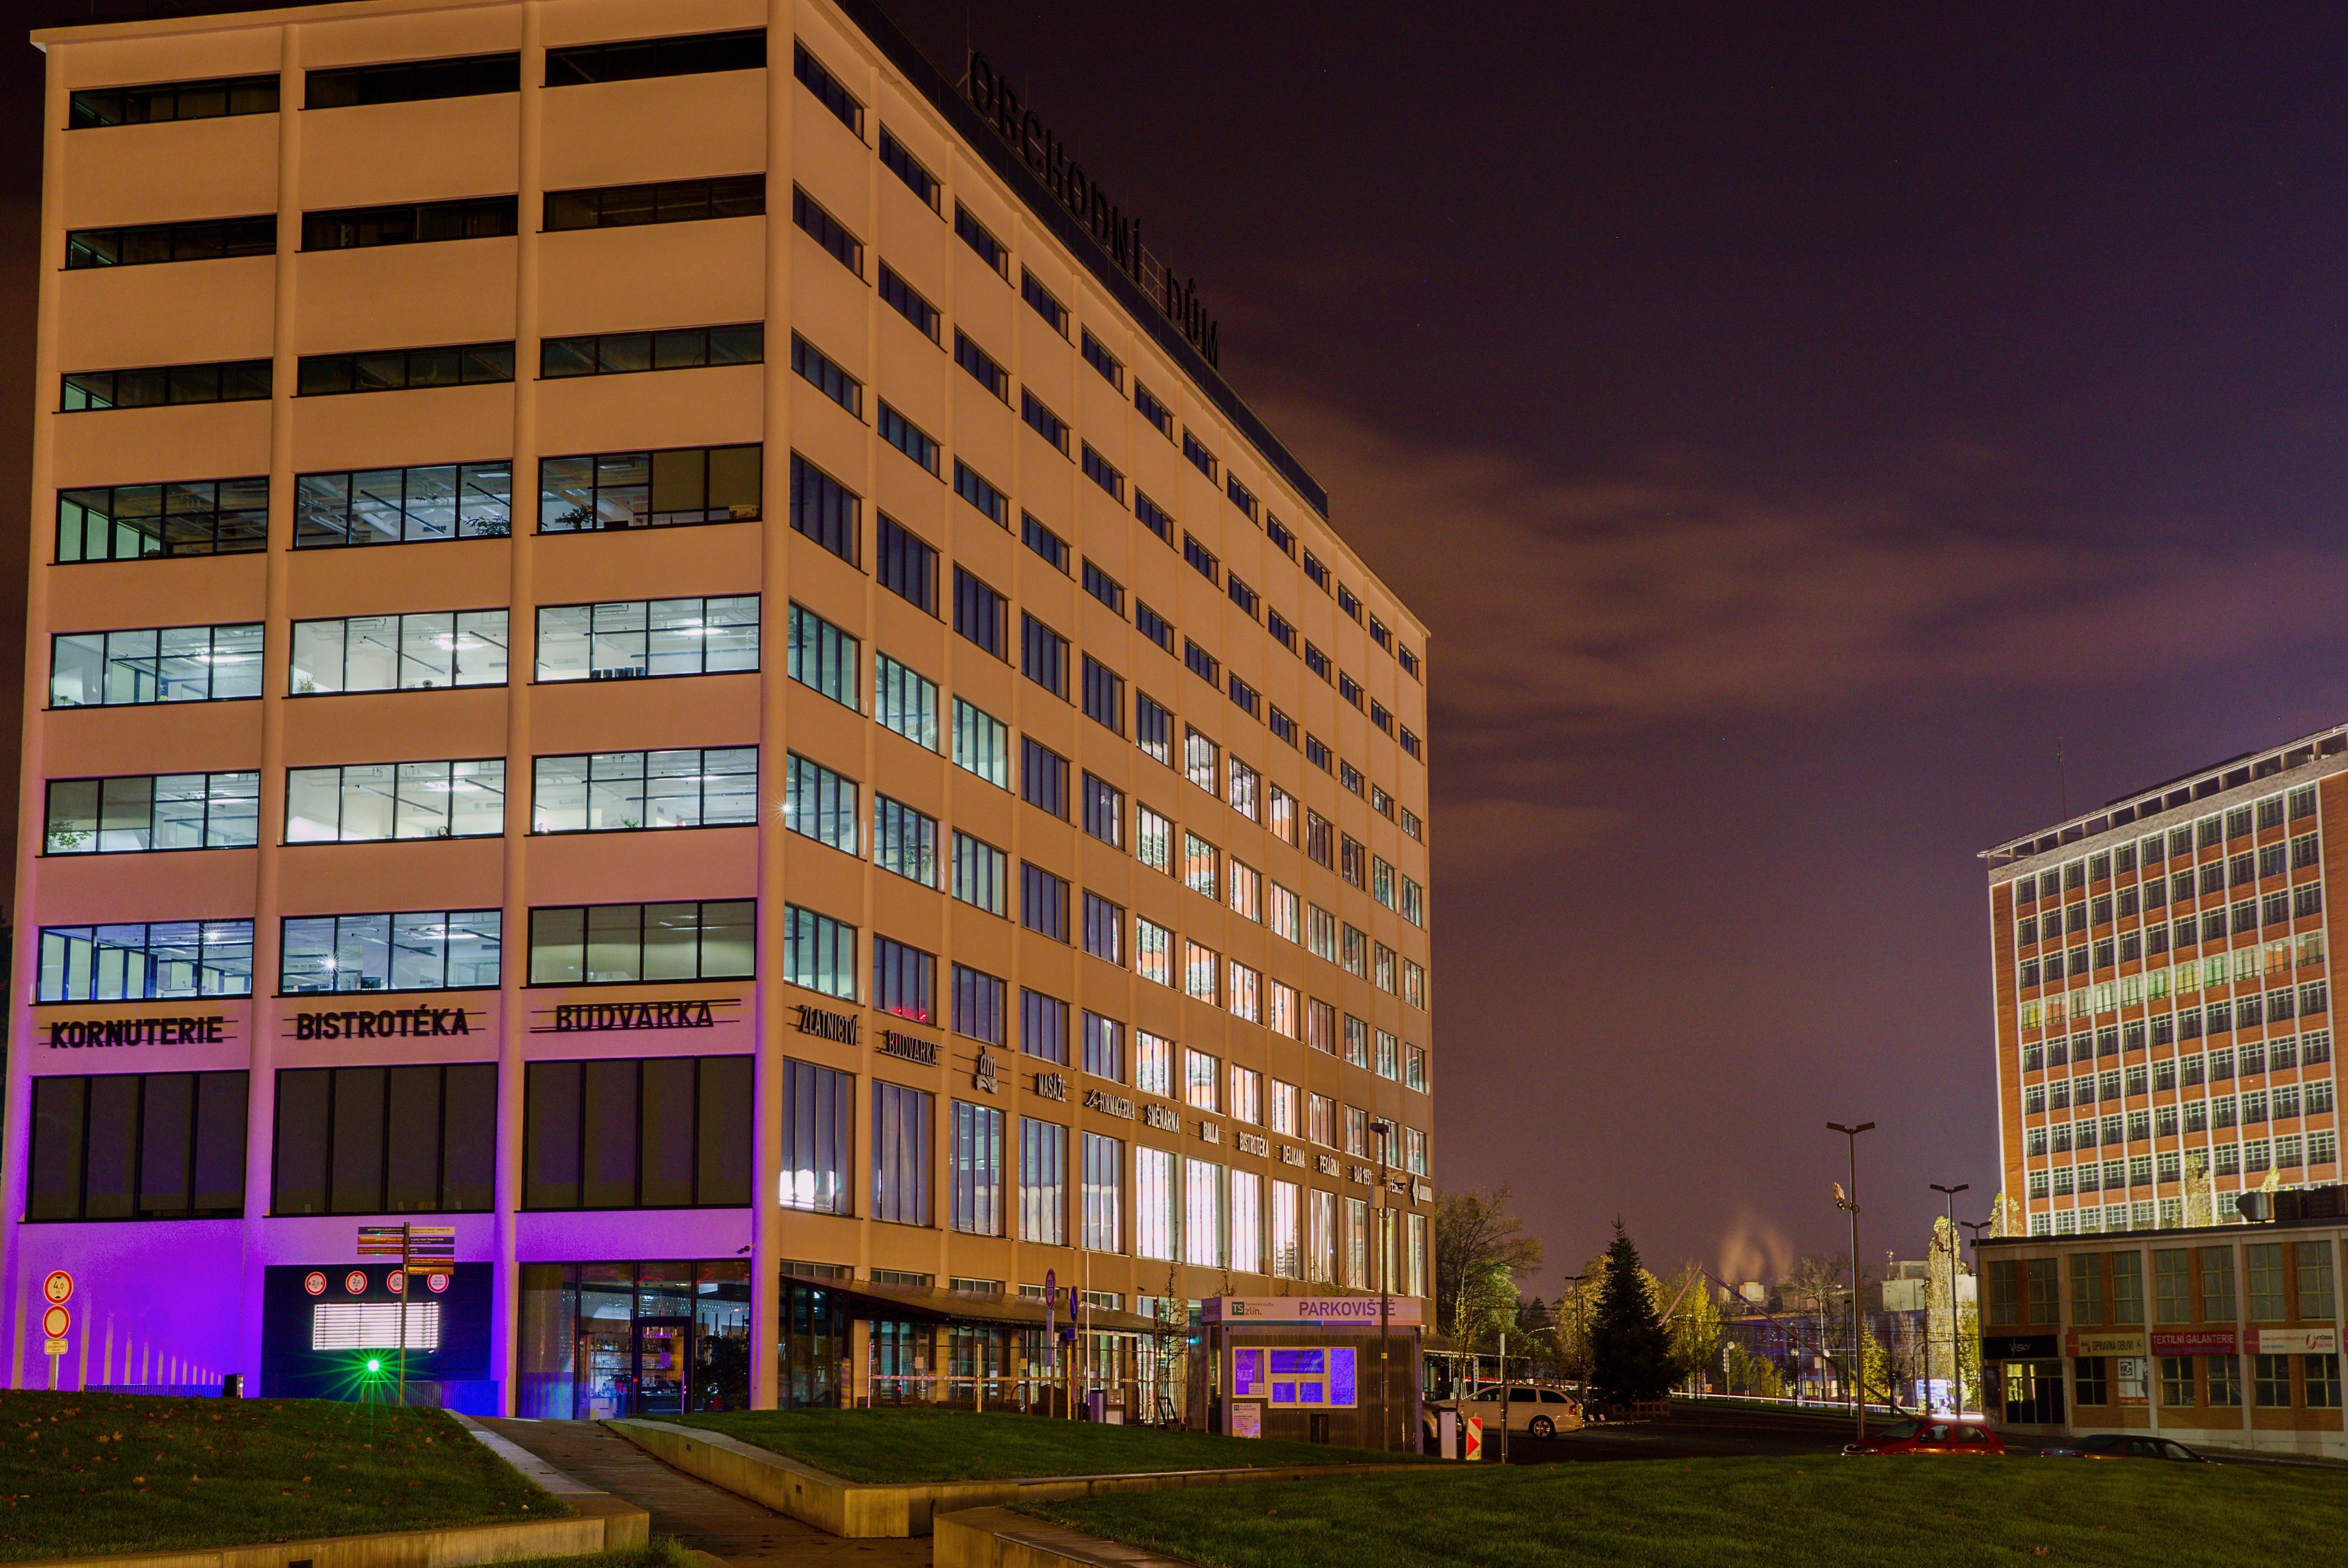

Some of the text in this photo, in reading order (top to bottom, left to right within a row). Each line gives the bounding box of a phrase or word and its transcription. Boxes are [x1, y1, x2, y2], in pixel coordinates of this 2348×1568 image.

[971, 52, 1218, 371] OBCHODNÍ DŮM
[297, 1004, 469, 1040] BISTROTÉKA
[557, 1000, 714, 1031] BUDVARKA
[801, 1005, 858, 1045] ZLATNICTVÍ
[50, 1016, 224, 1049] KORNUTERIE
[888, 1031, 938, 1066] BUDVARKA
[980, 1046, 996, 1077] dm
[1038, 1073, 1067, 1102] MASÁŽE
[1147, 1103, 1179, 1134] SMĚNÁRNA
[1203, 1121, 1219, 1144] BILLA
[1240, 1131, 1269, 1158] BISTROTÉKA
[1283, 1144, 1305, 1168] DELIKANA
[1320, 1154, 1340, 1178] PEKÁRNA
[1354, 1165, 1372, 1186] BAR 1931
[1233, 1304, 1243, 1313] TS
[1299, 1299, 1396, 1316] PARKOVIŠTĚ
[2093, 1340, 2134, 1350] OPRAVNA OBUVI
[2152, 1333, 2234, 1344] TEXTILNÍ GALANTERIE
